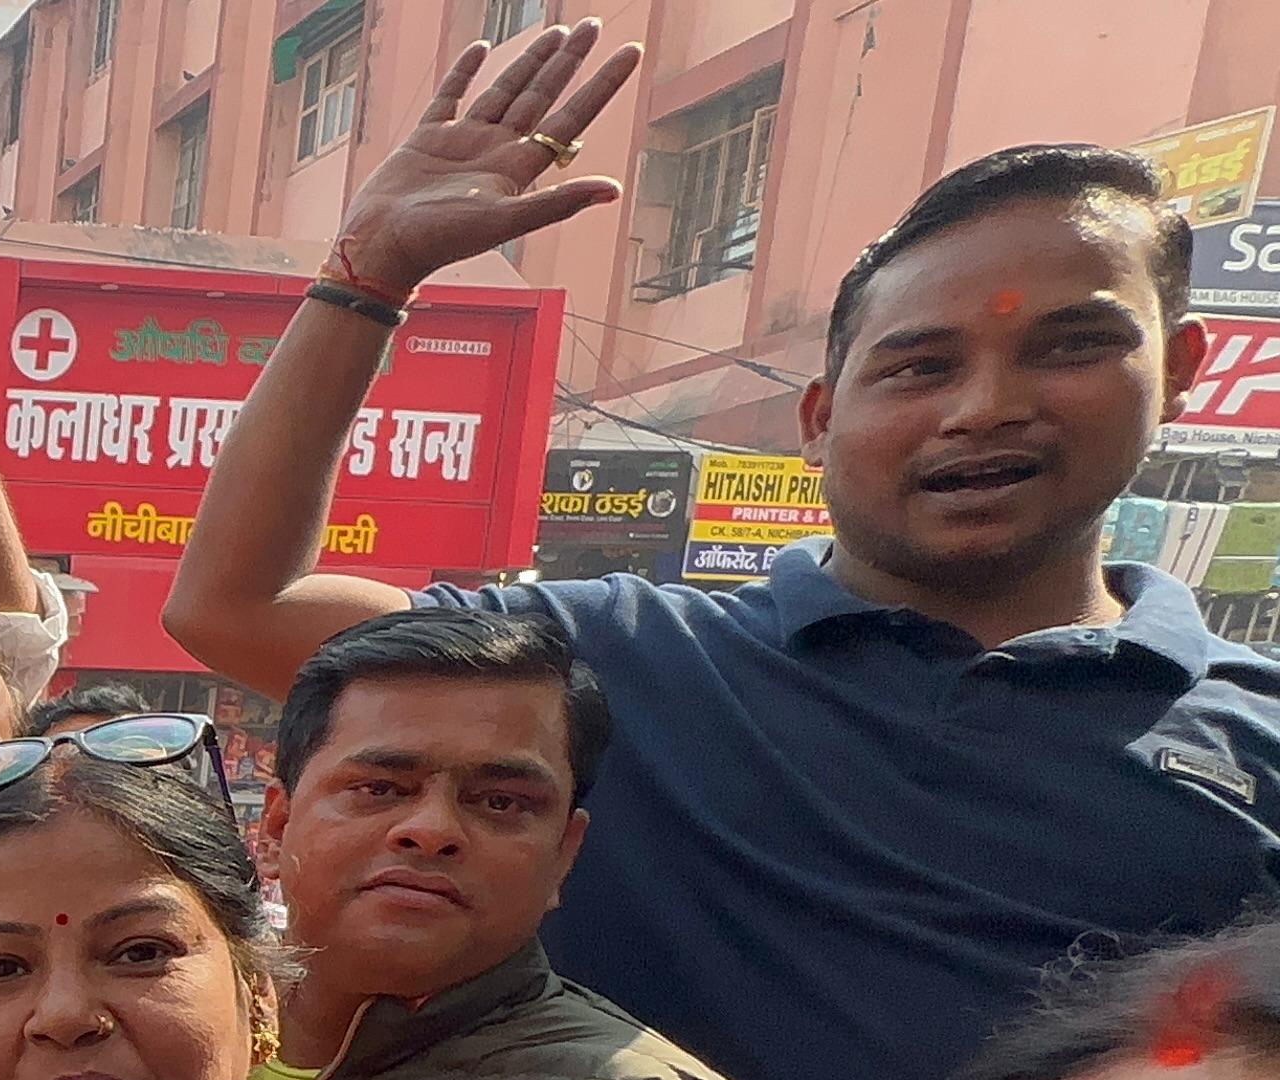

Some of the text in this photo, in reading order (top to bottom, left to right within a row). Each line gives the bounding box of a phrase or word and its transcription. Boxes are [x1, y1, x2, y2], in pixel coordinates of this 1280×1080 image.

[5, 388, 161, 465] कलाधर
[388, 409, 482, 482] सन्स
[1161, 427, 1189, 444] Bag
[703, 472, 784, 503] HITAISHI
[731, 506, 800, 523] PRINTER
[802, 511, 814, 523] &
